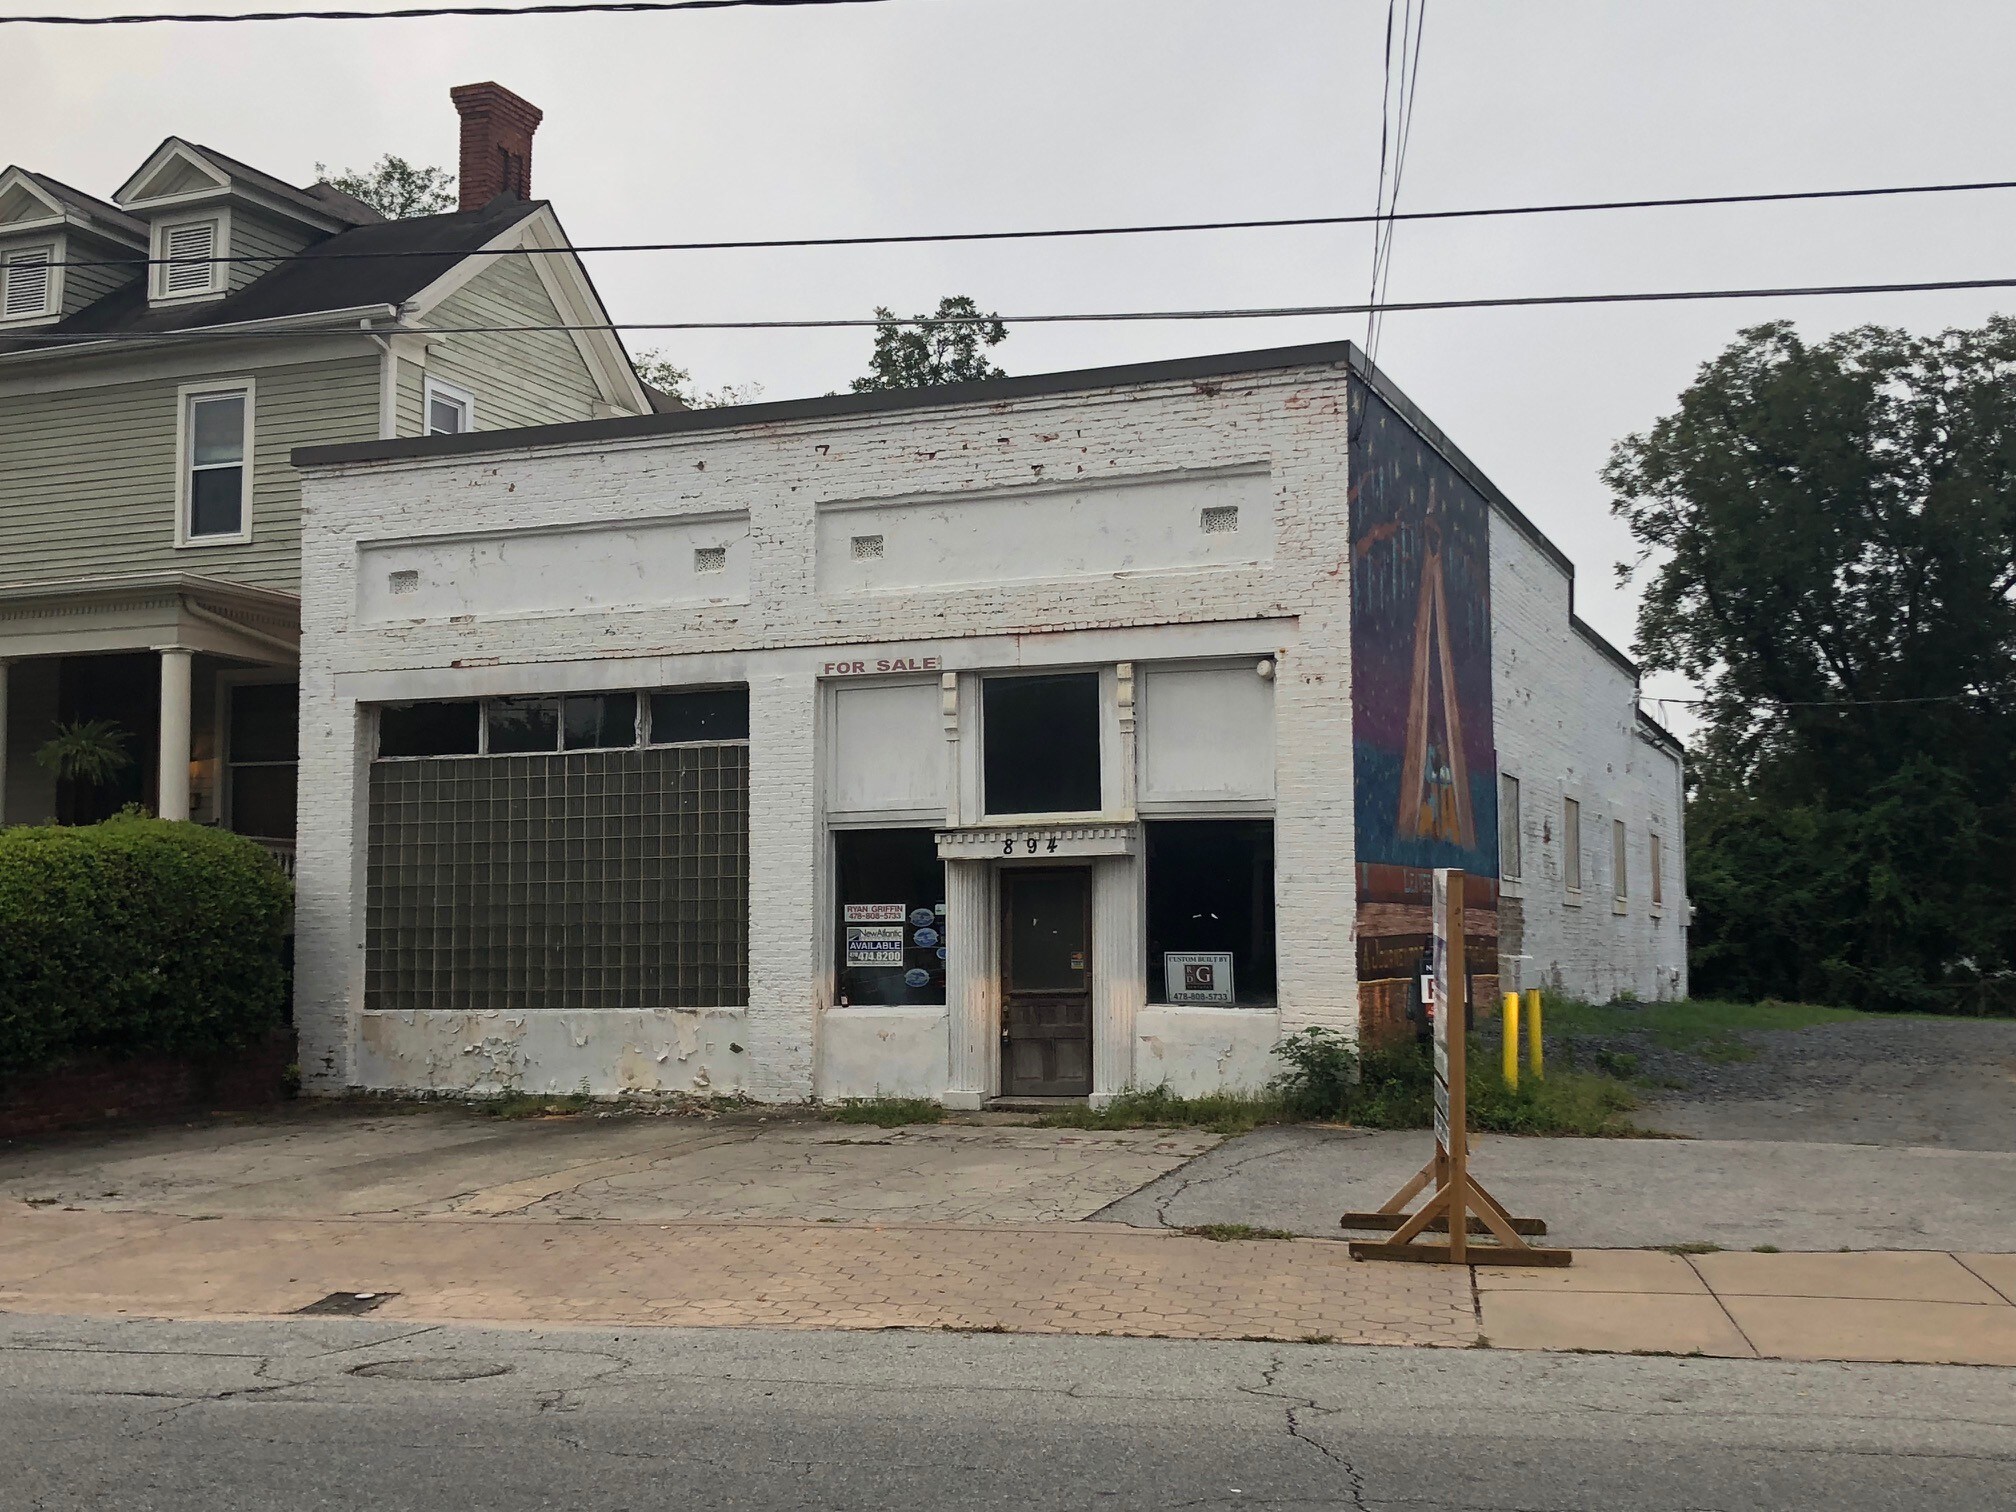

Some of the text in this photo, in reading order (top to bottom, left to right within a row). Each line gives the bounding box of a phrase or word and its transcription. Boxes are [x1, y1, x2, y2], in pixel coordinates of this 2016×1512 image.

[824, 657, 937, 675] FOR SALE
[1003, 836, 1059, 855] 894
